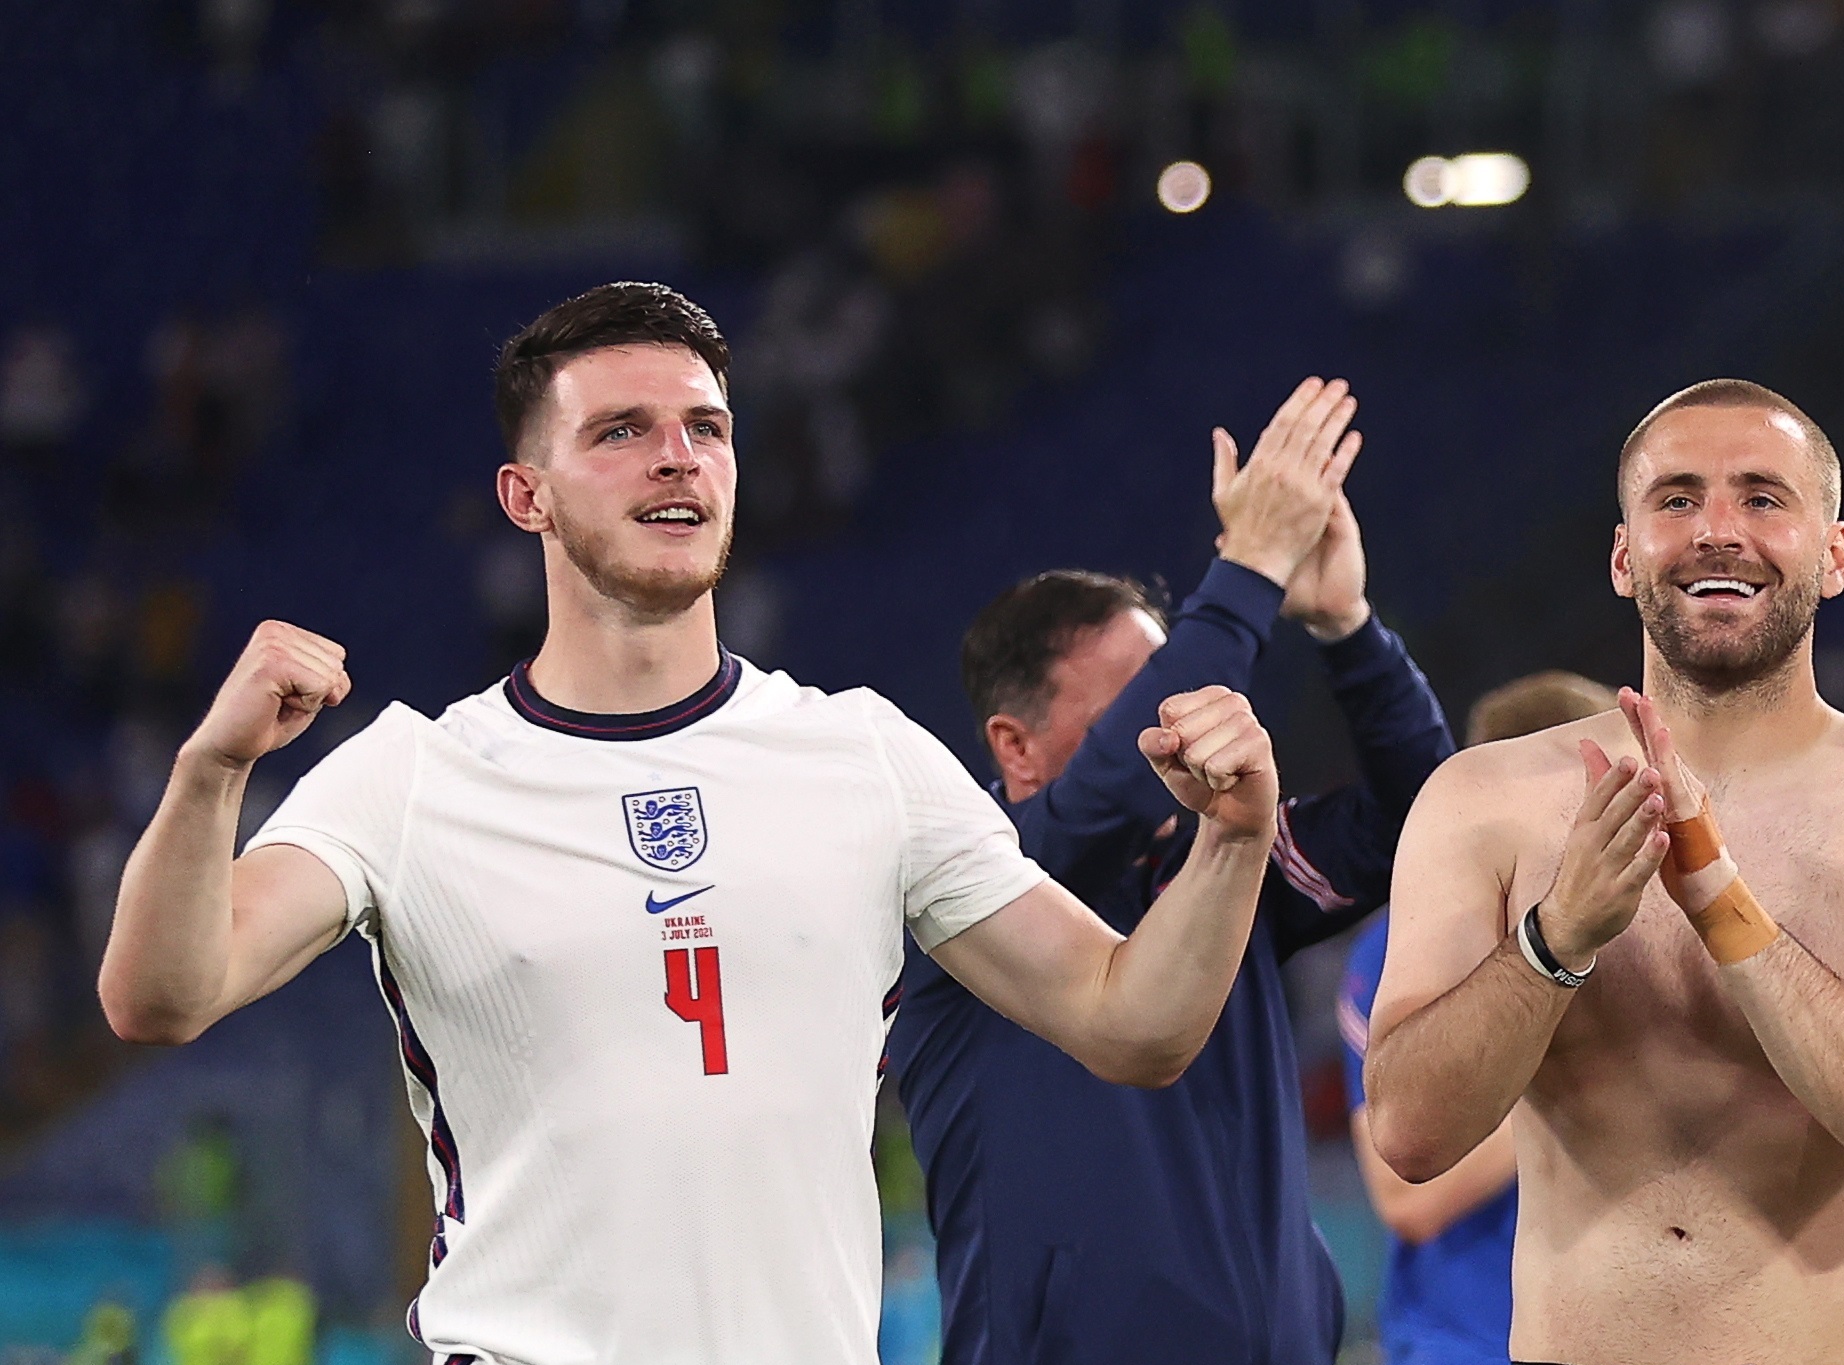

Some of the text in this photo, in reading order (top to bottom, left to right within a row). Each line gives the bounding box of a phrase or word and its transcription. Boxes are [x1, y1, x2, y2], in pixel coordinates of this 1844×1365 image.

[664, 915, 707, 928] UKRAINE
[661, 927, 713, 941] 3 JULY 2021
[663, 946, 728, 1076] 4
